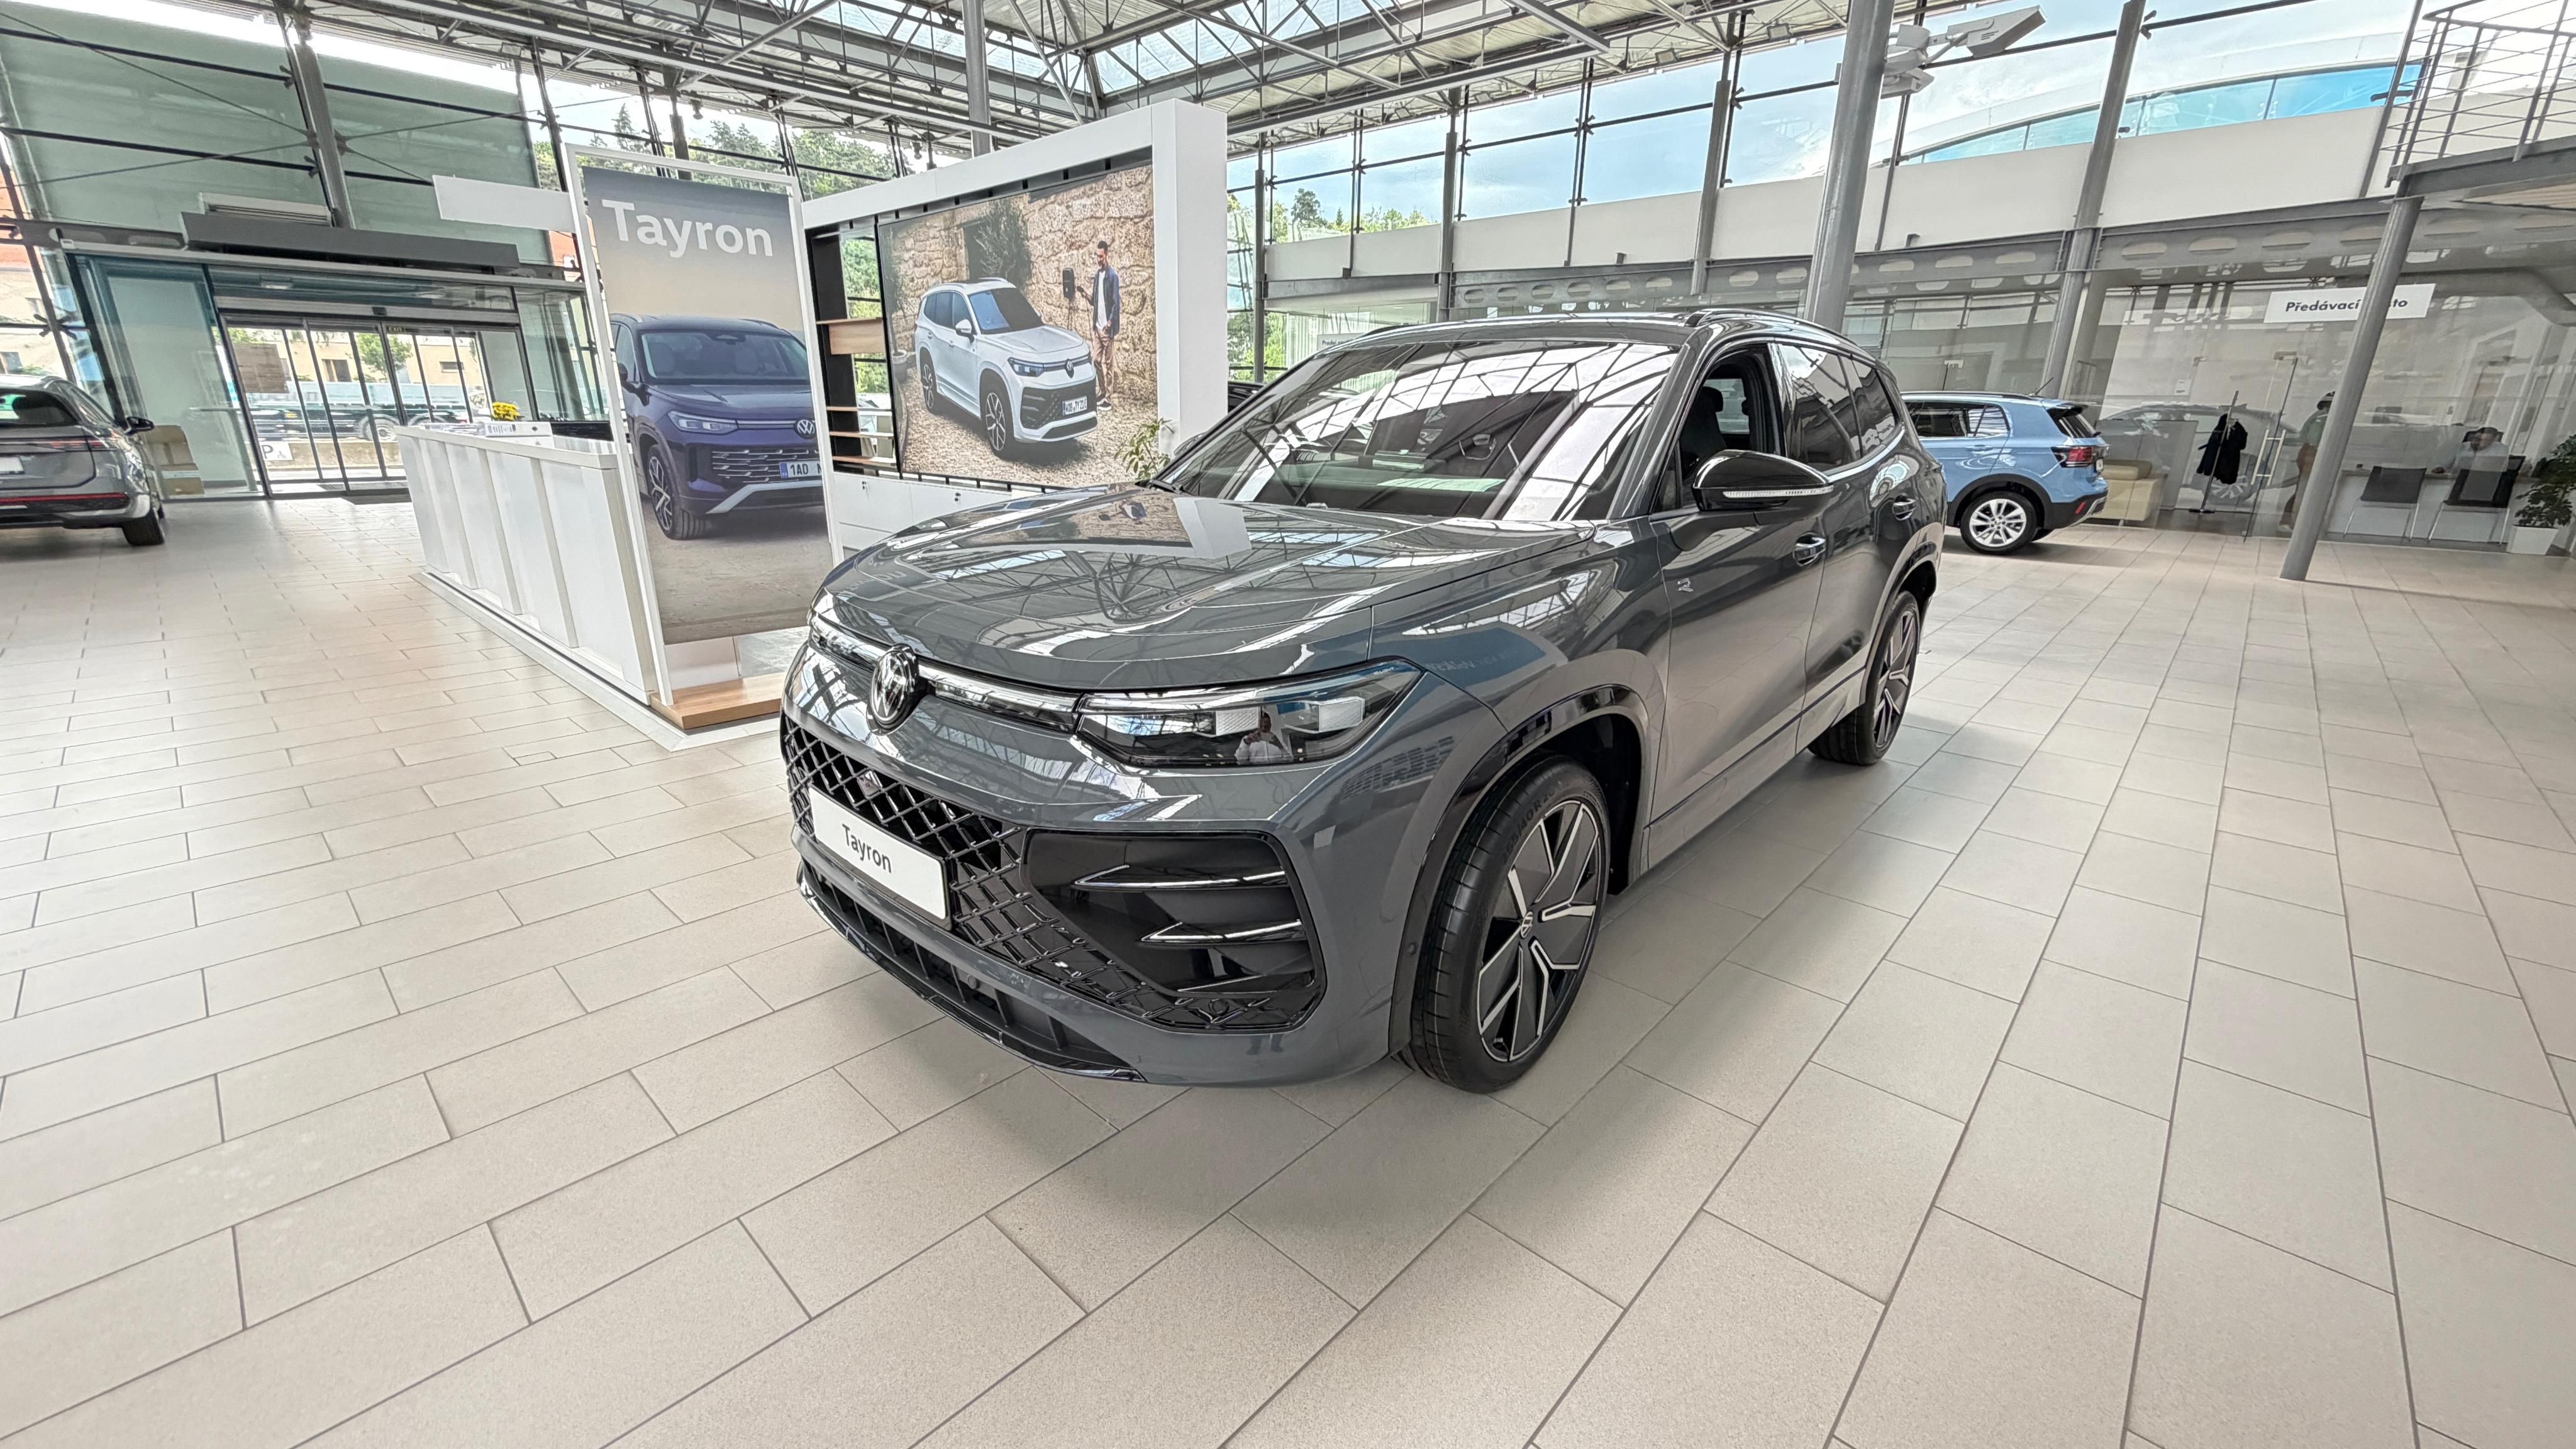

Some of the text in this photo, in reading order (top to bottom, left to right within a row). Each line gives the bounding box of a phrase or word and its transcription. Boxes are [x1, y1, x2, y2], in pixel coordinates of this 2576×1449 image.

[601, 199, 773, 258] Tayron
[2285, 299, 2362, 312] Předávací
[262, 445, 274, 459] P
[791, 464, 809, 475] 1AD
[842, 823, 892, 874] Tayron
